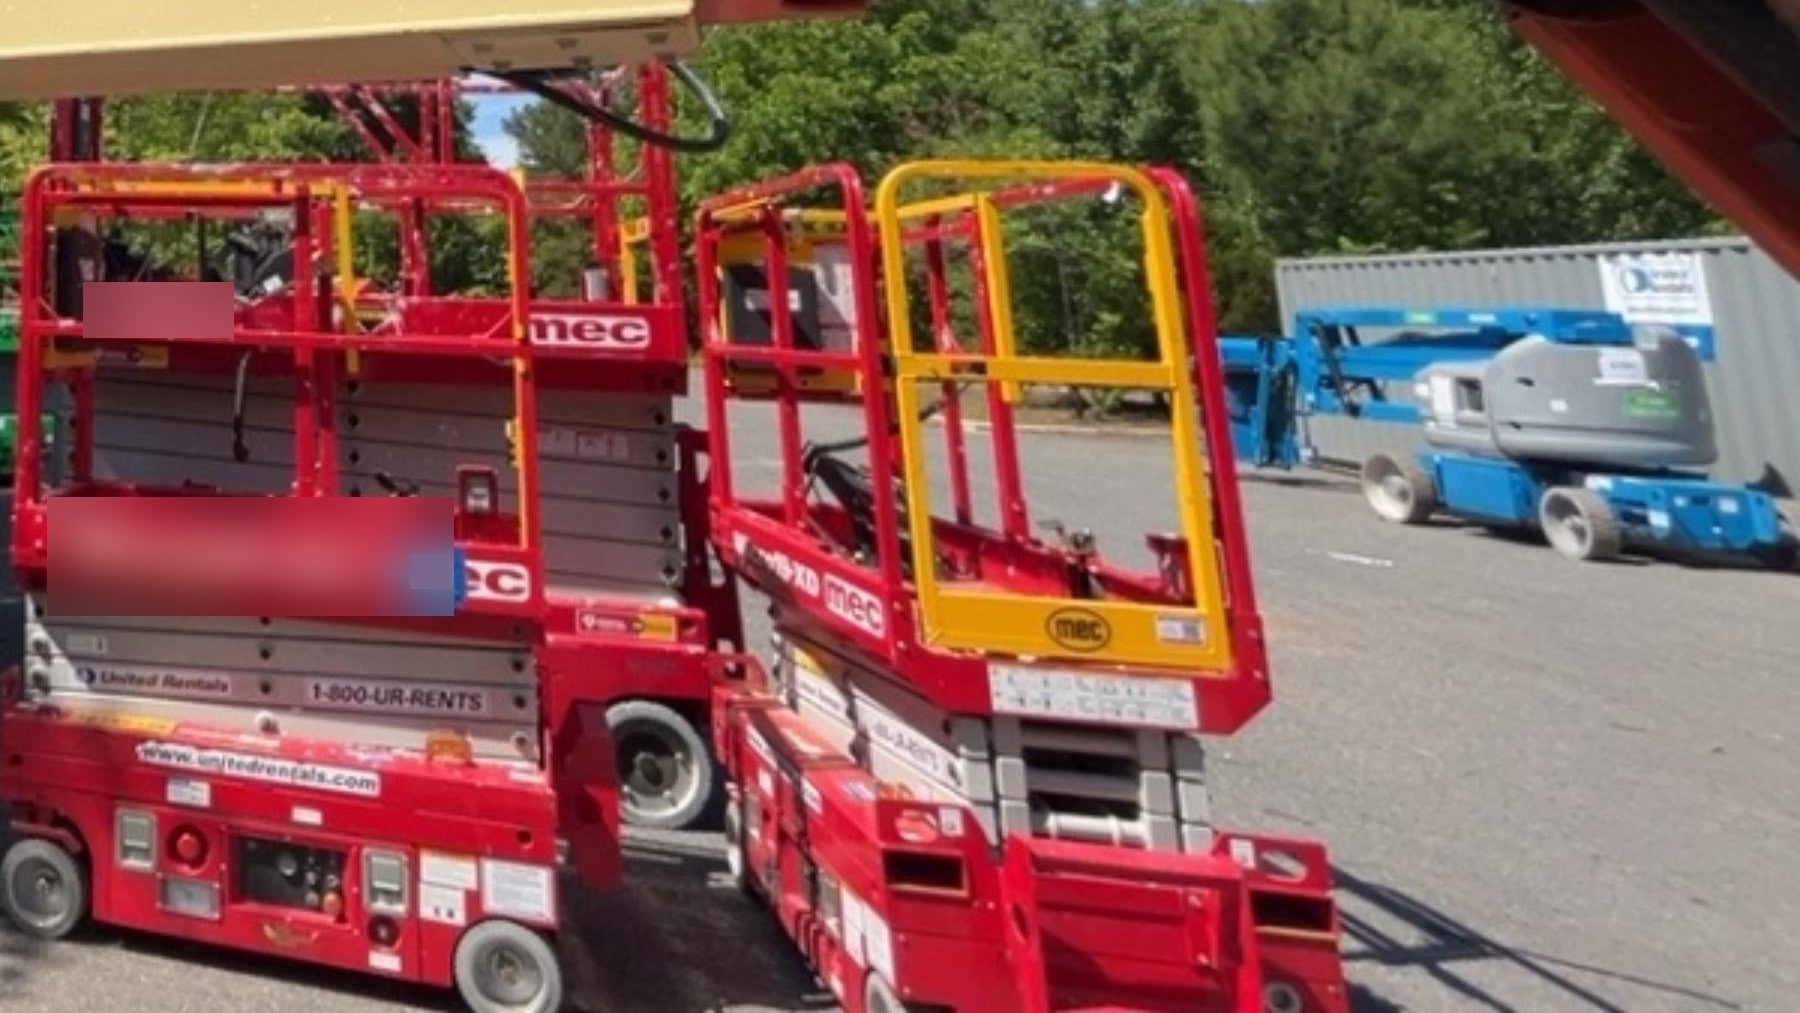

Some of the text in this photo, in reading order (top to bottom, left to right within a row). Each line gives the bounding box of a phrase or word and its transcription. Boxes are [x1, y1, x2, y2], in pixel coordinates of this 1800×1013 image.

[528, 317, 646, 344] mec
[827, 581, 882, 631] mec
[1055, 617, 1104, 642] mec
[312, 684, 482, 712] 1-800-UR-RENTS
